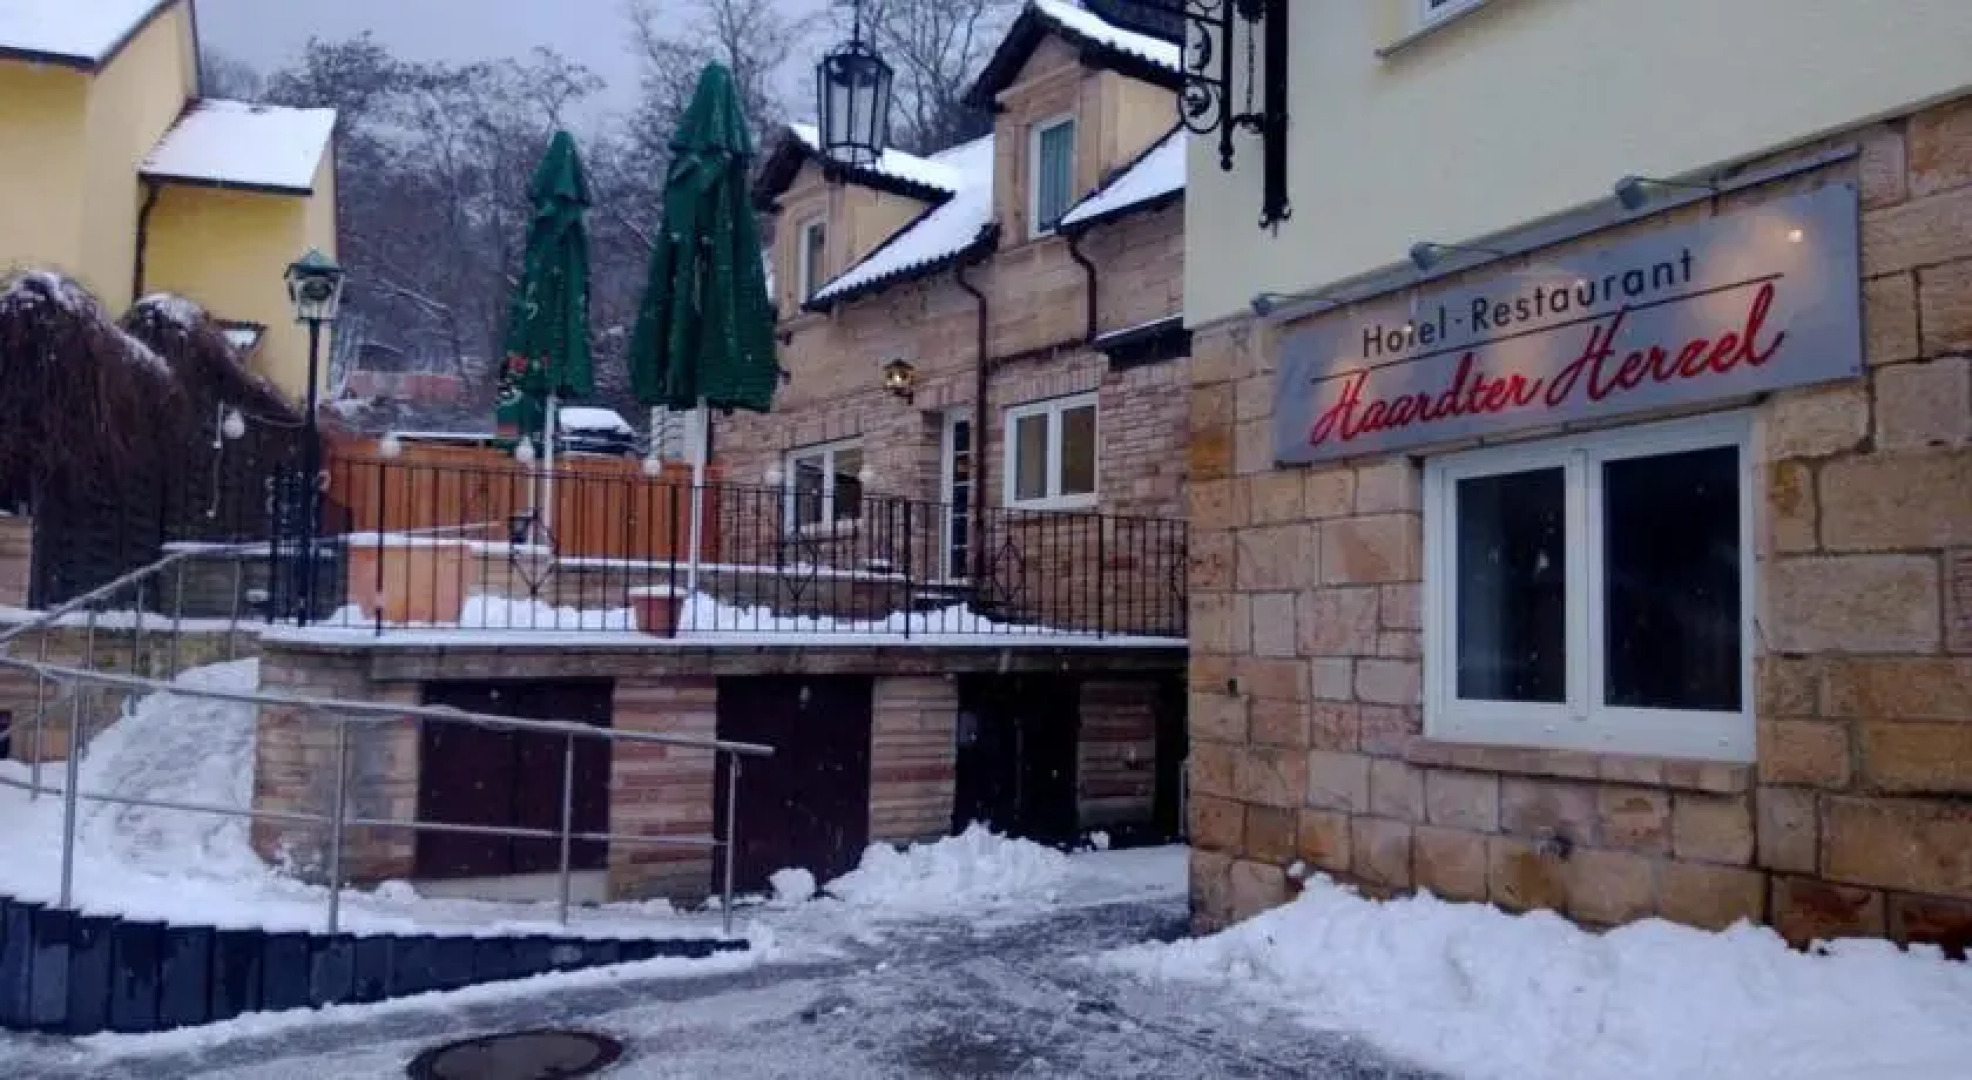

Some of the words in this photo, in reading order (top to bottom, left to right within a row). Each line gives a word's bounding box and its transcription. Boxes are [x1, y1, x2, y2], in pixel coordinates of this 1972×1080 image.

[1471, 249, 1695, 332] Restaurant
[1311, 352, 1543, 446] Haardter
[1547, 283, 1785, 407] Herzel
